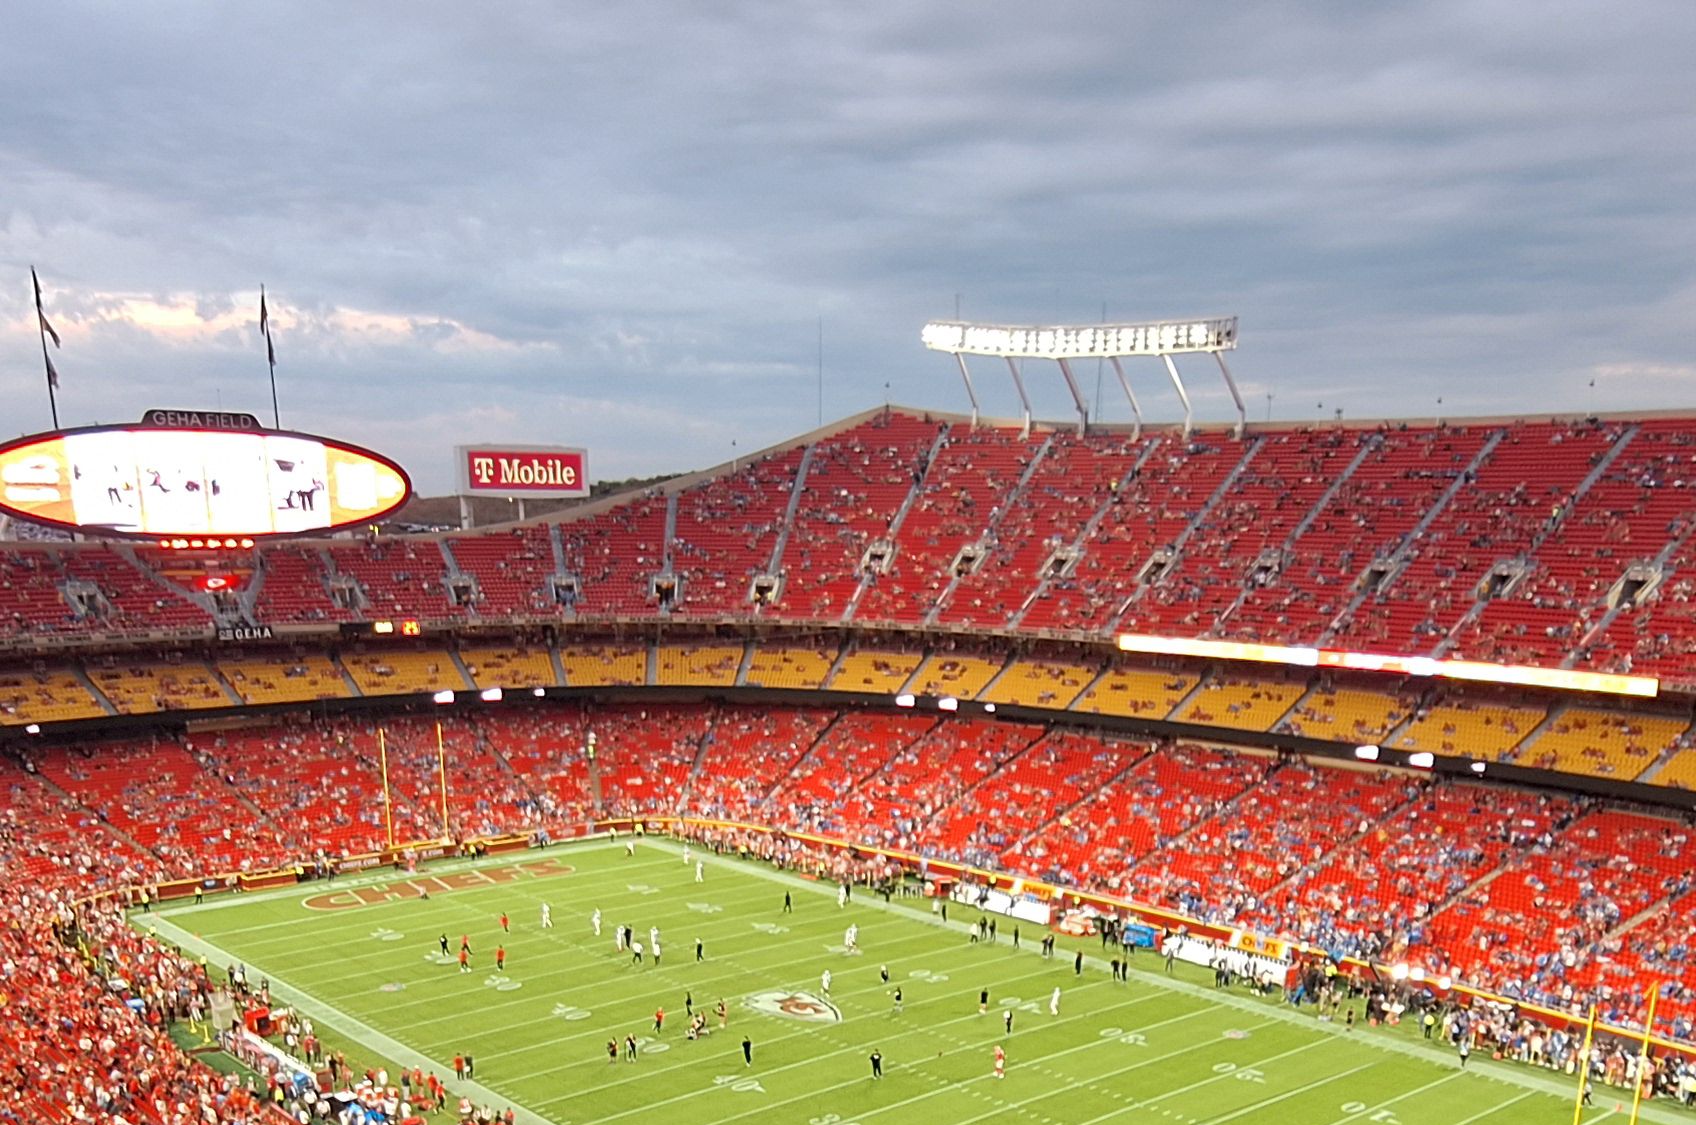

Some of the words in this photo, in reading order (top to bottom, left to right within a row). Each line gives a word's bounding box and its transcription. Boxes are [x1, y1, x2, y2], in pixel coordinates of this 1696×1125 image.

[152, 411, 202, 427] GEHA
[205, 413, 253, 428] FIELD
[474, 457, 495, 484] T
[498, 458, 576, 485] Mobile
[235, 627, 272, 640] GEHA
[302, 858, 576, 911] CHIEFS
[1241, 935, 1279, 954] CHFS
[1099, 1027, 1146, 1045] 30
[1211, 1062, 1265, 1082] 20
[712, 1074, 759, 1092] 40
[1340, 1100, 1397, 1123] 10
